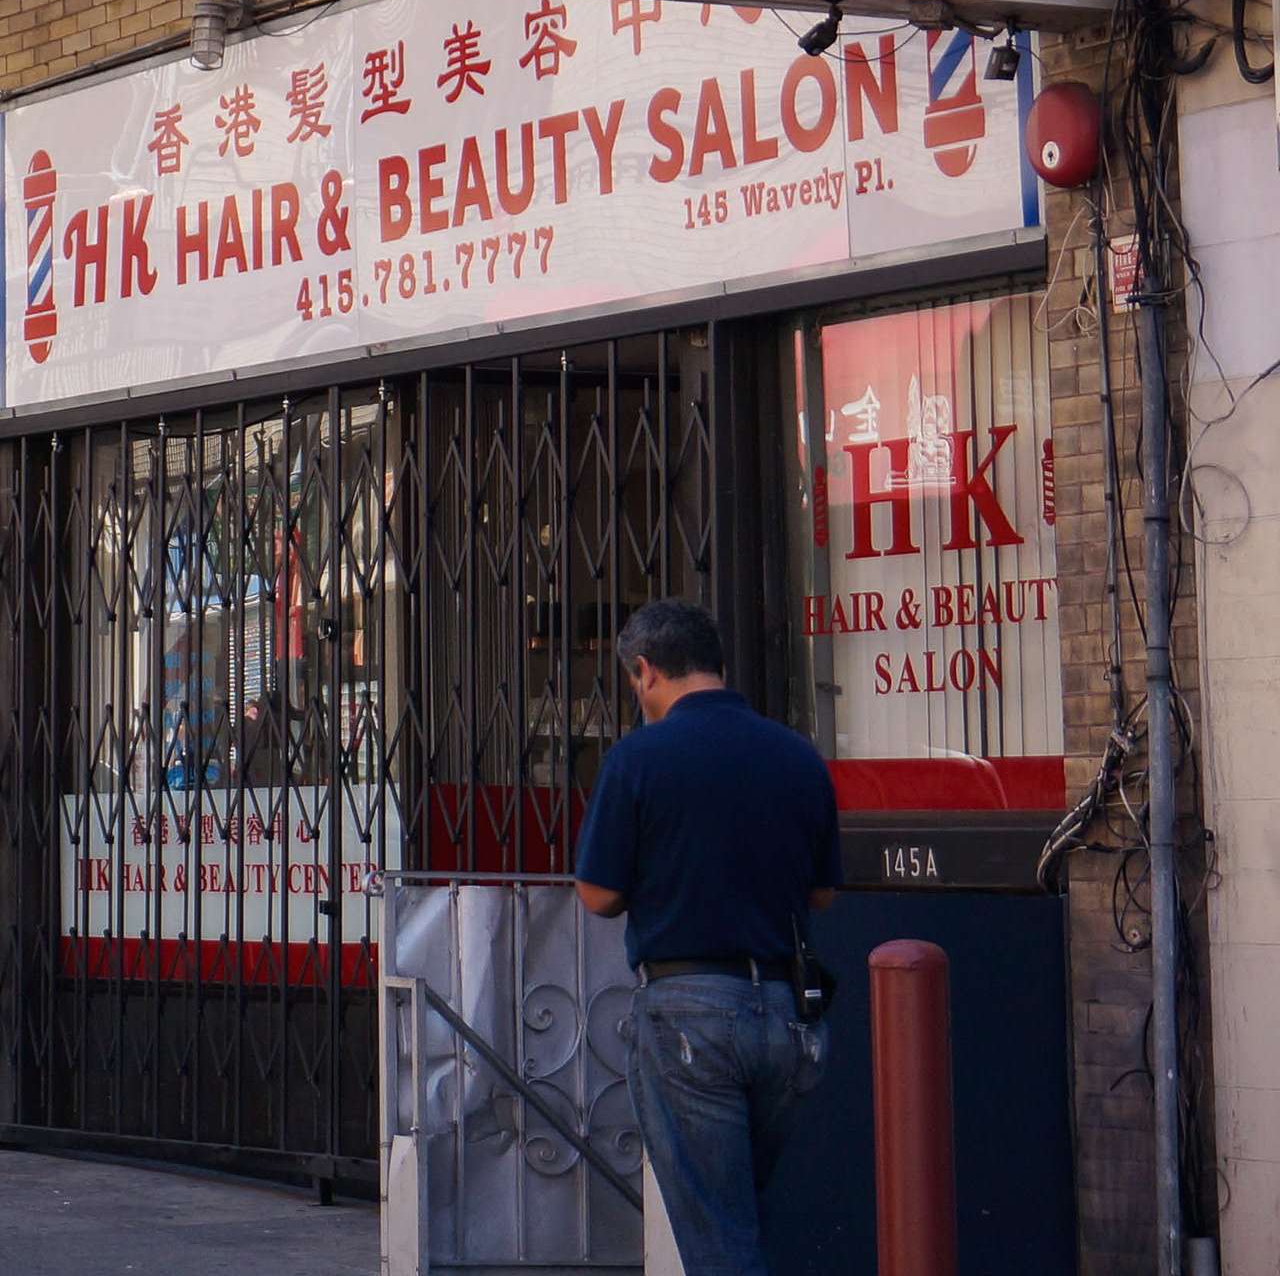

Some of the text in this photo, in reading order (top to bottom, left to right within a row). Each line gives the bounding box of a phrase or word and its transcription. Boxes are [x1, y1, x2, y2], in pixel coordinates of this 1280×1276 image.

[62, 34, 899, 308] HK HAIR & BEAUTY SALON
[683, 157, 895, 230] 145 Waverly Pl.
[295, 225, 555, 323] 415.781.7777
[842, 424, 1026, 560] HK
[801, 591, 888, 636] HAIR
[895, 586, 923, 631] &
[874, 647, 1004, 696] SALON
[882, 846, 939, 880] 145A
